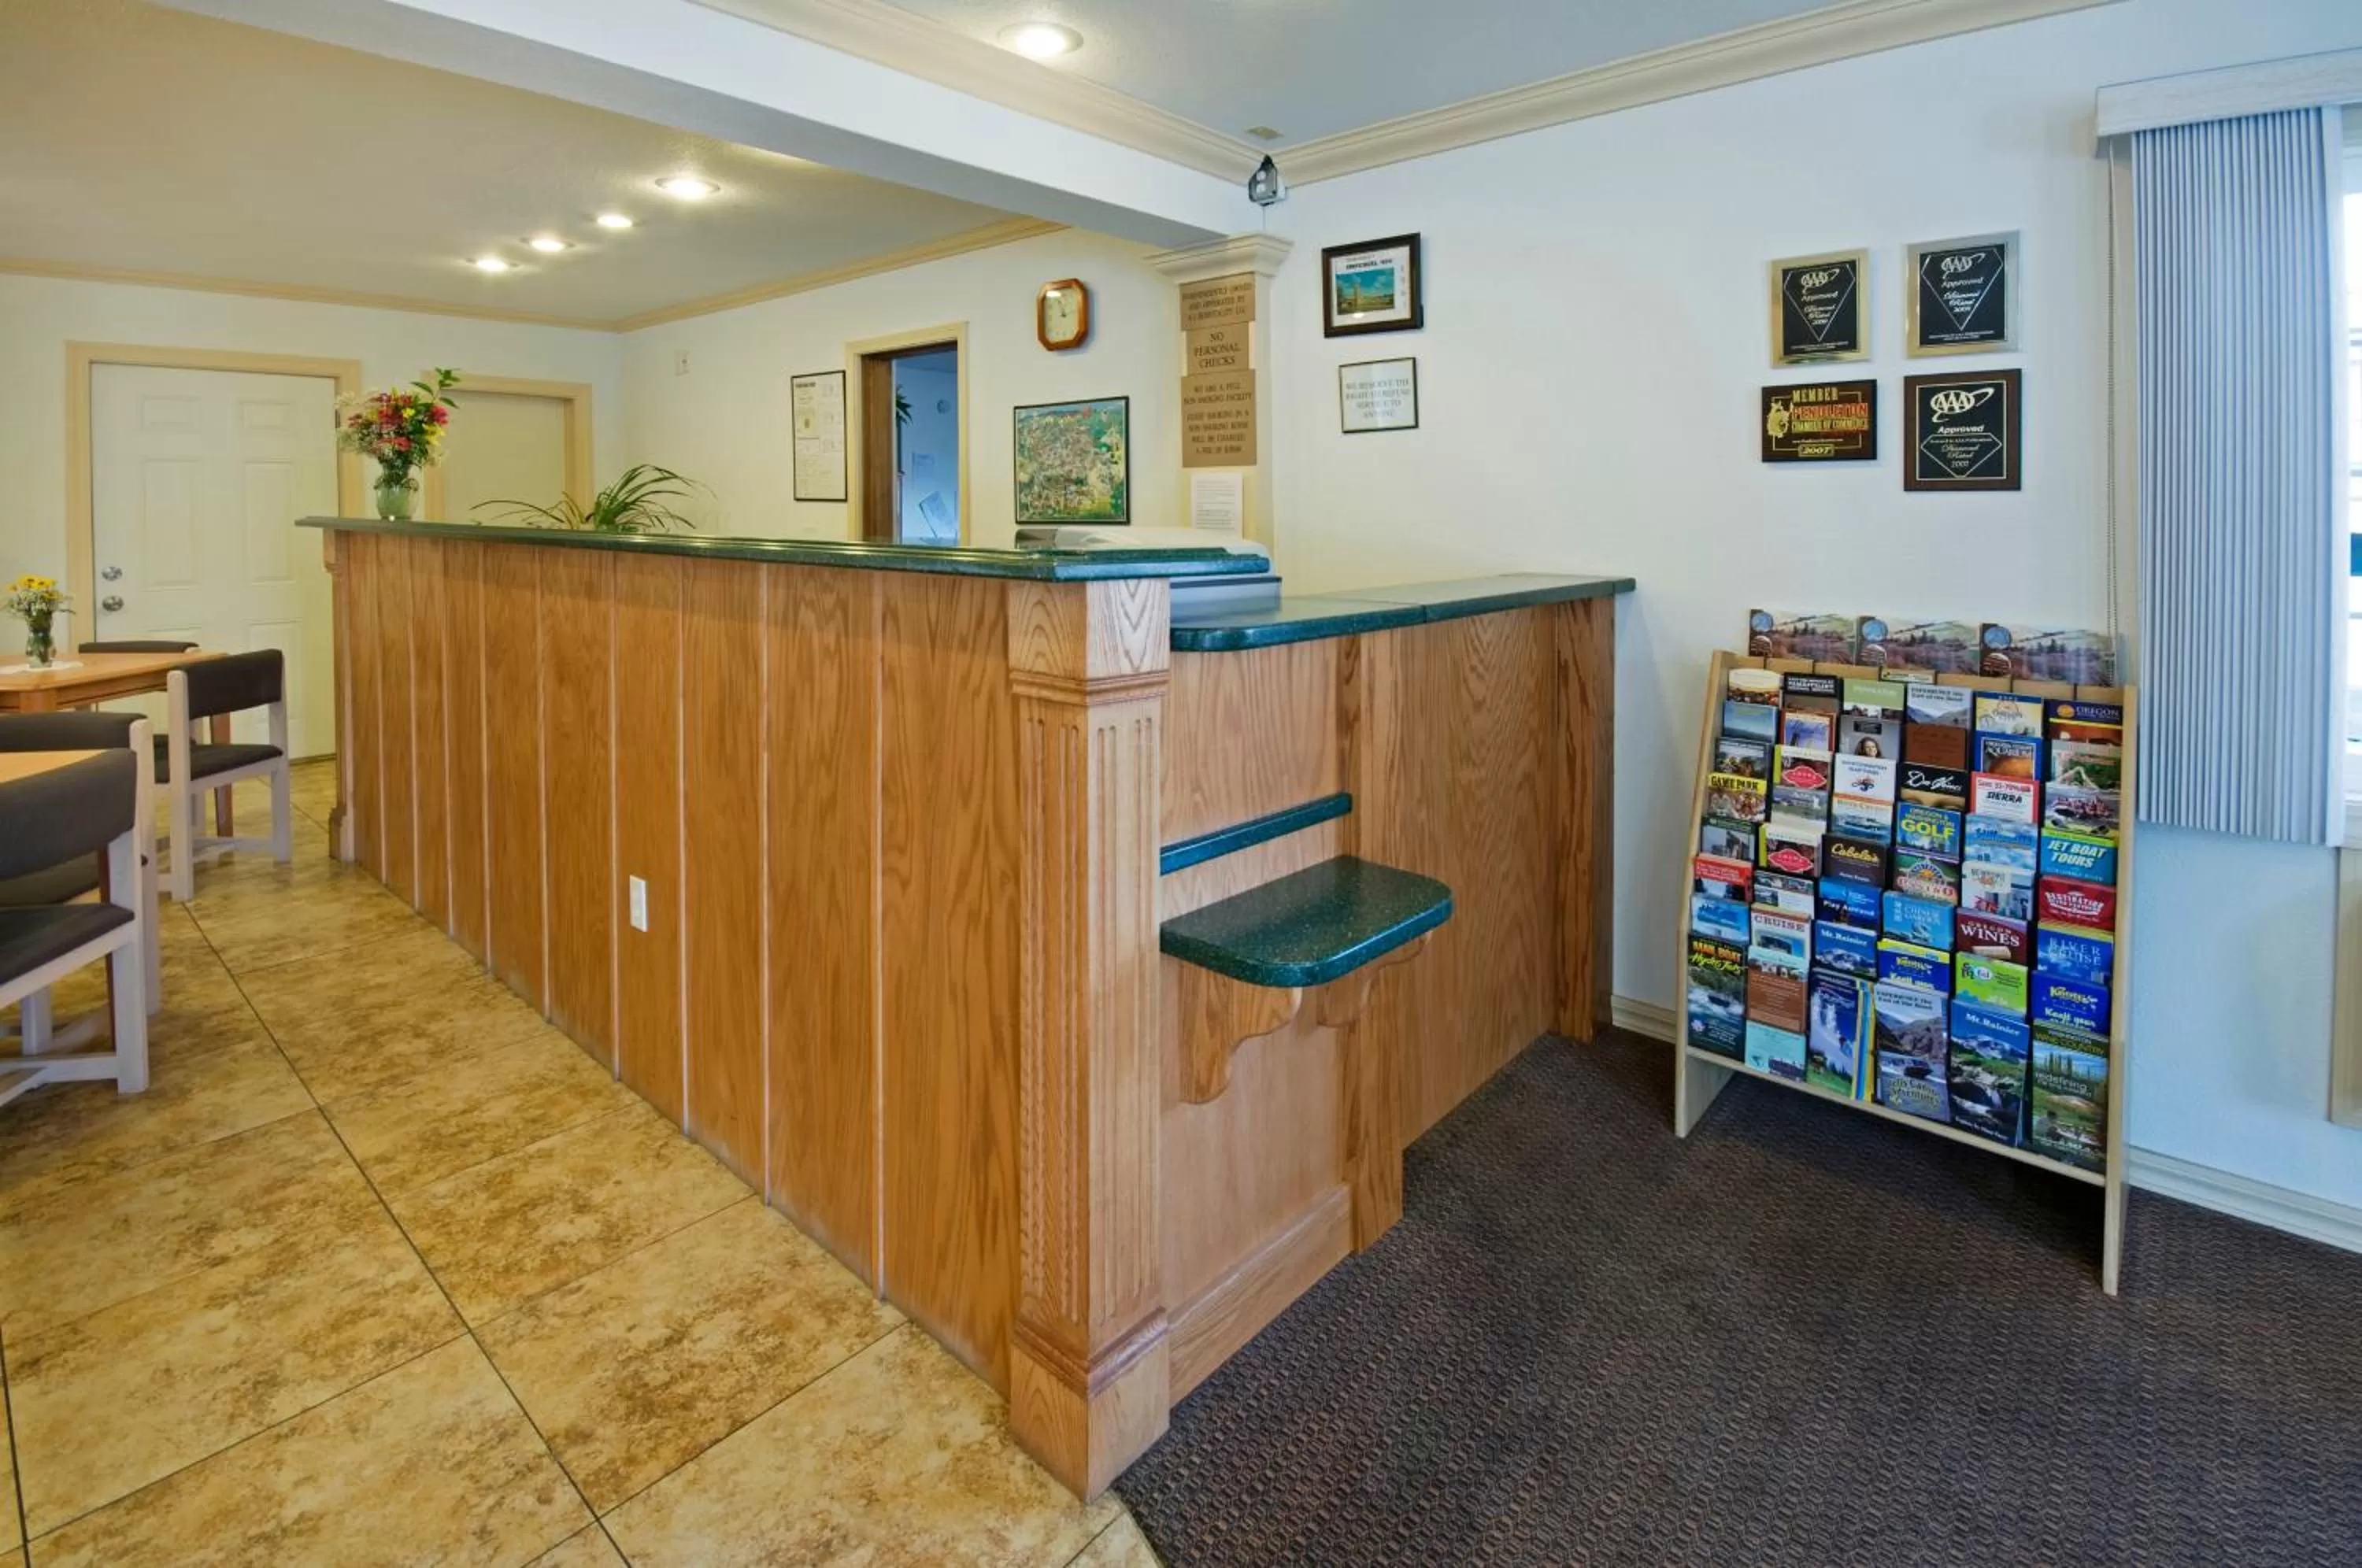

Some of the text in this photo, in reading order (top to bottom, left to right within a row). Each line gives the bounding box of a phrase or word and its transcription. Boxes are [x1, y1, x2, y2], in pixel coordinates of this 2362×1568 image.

[1209, 331, 1224, 342] NO
[1194, 343, 1242, 357] PERSONAL
[1198, 355, 1235, 368] CHECKS
[1792, 386, 1838, 403] MEMBER
[1935, 390, 1971, 414] AAA
[1937, 425, 1985, 435] Approved
[1803, 446, 1831, 454] 2007
[2076, 705, 2120, 718] OREGON
[1711, 775, 1759, 790] GAME PARK
[1986, 791, 2023, 804] SIERRA
[1901, 818, 1956, 839] GOLF
[1831, 843, 1880, 864] Cabela's
[2048, 840, 2108, 858] JET BOAT
[2050, 852, 2095, 869] TOURS
[1823, 900, 1841, 911] Play
[1754, 915, 1805, 933] CRUISE
[1960, 924, 2020, 947] WINES
[2049, 937, 2101, 956] RIVER
[1965, 1013, 2021, 1036] Mt. Rainier
